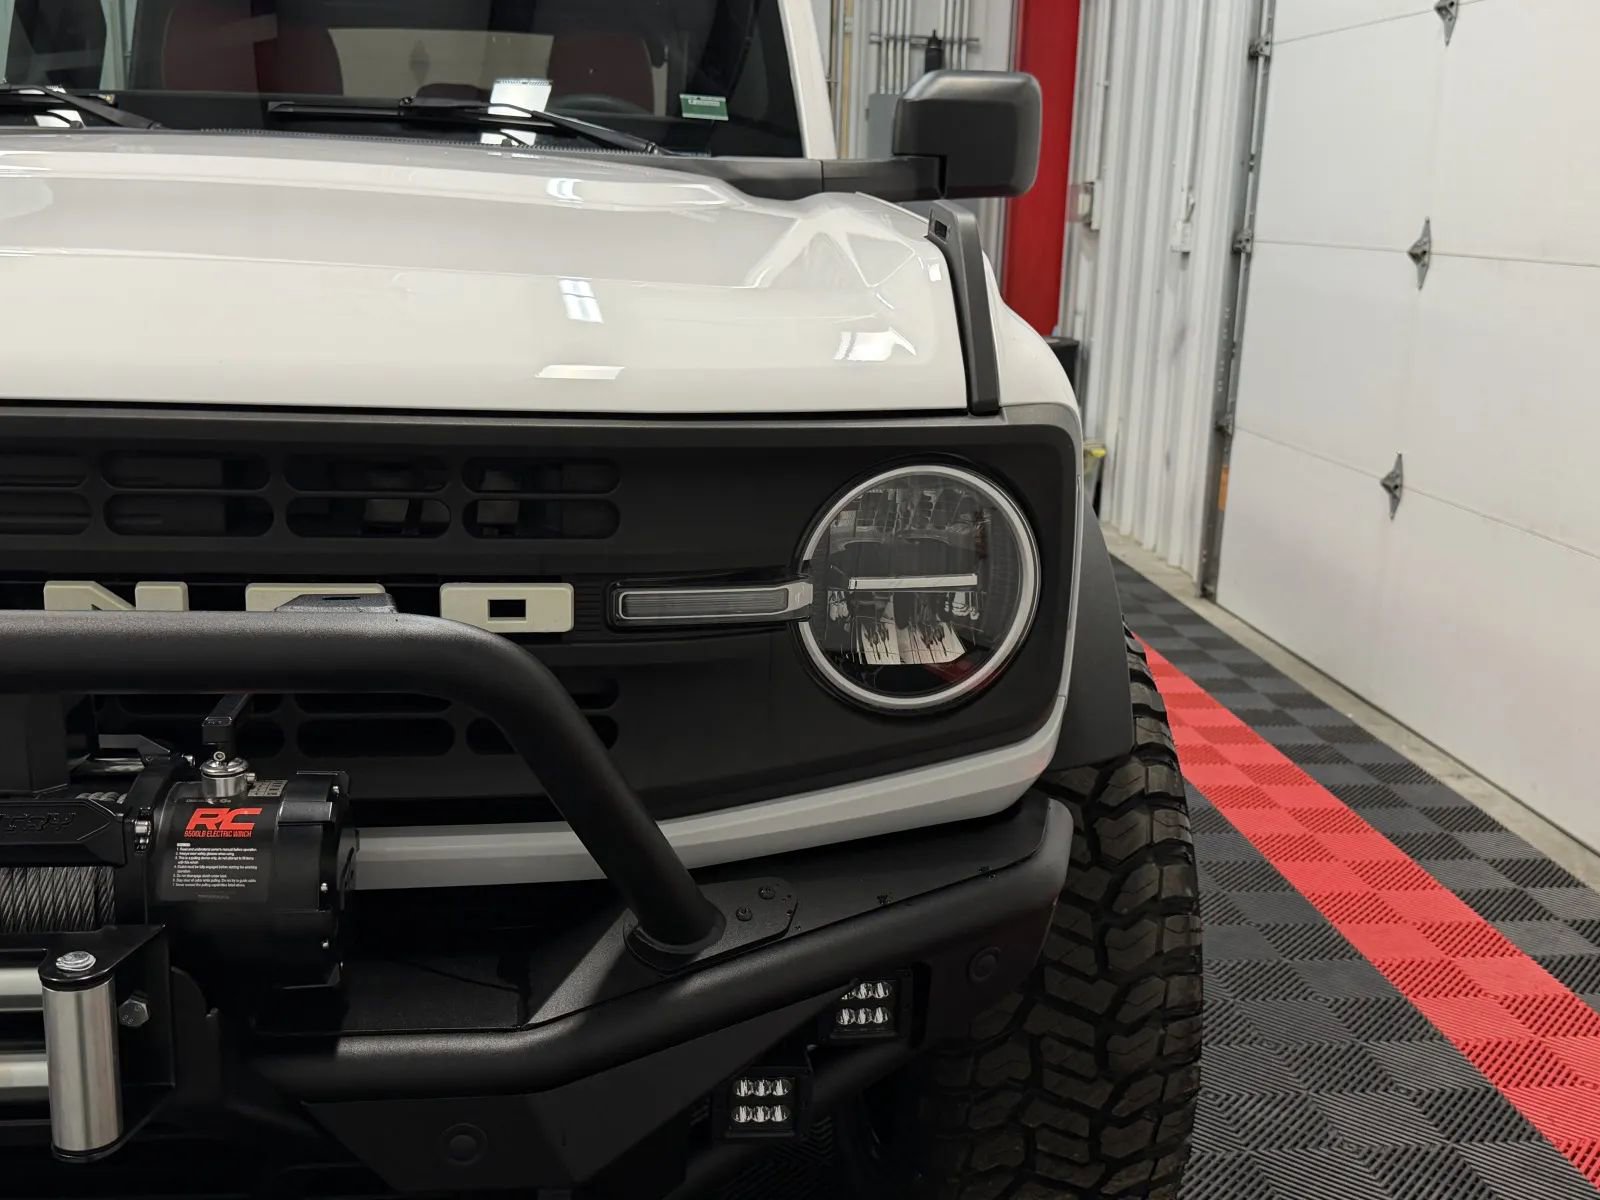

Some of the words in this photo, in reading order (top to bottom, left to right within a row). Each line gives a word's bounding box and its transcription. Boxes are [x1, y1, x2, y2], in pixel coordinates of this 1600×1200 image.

[186, 808, 262, 829] RC
[206, 830, 233, 838] ELECTRIC
[233, 830, 252, 838] WINCH
